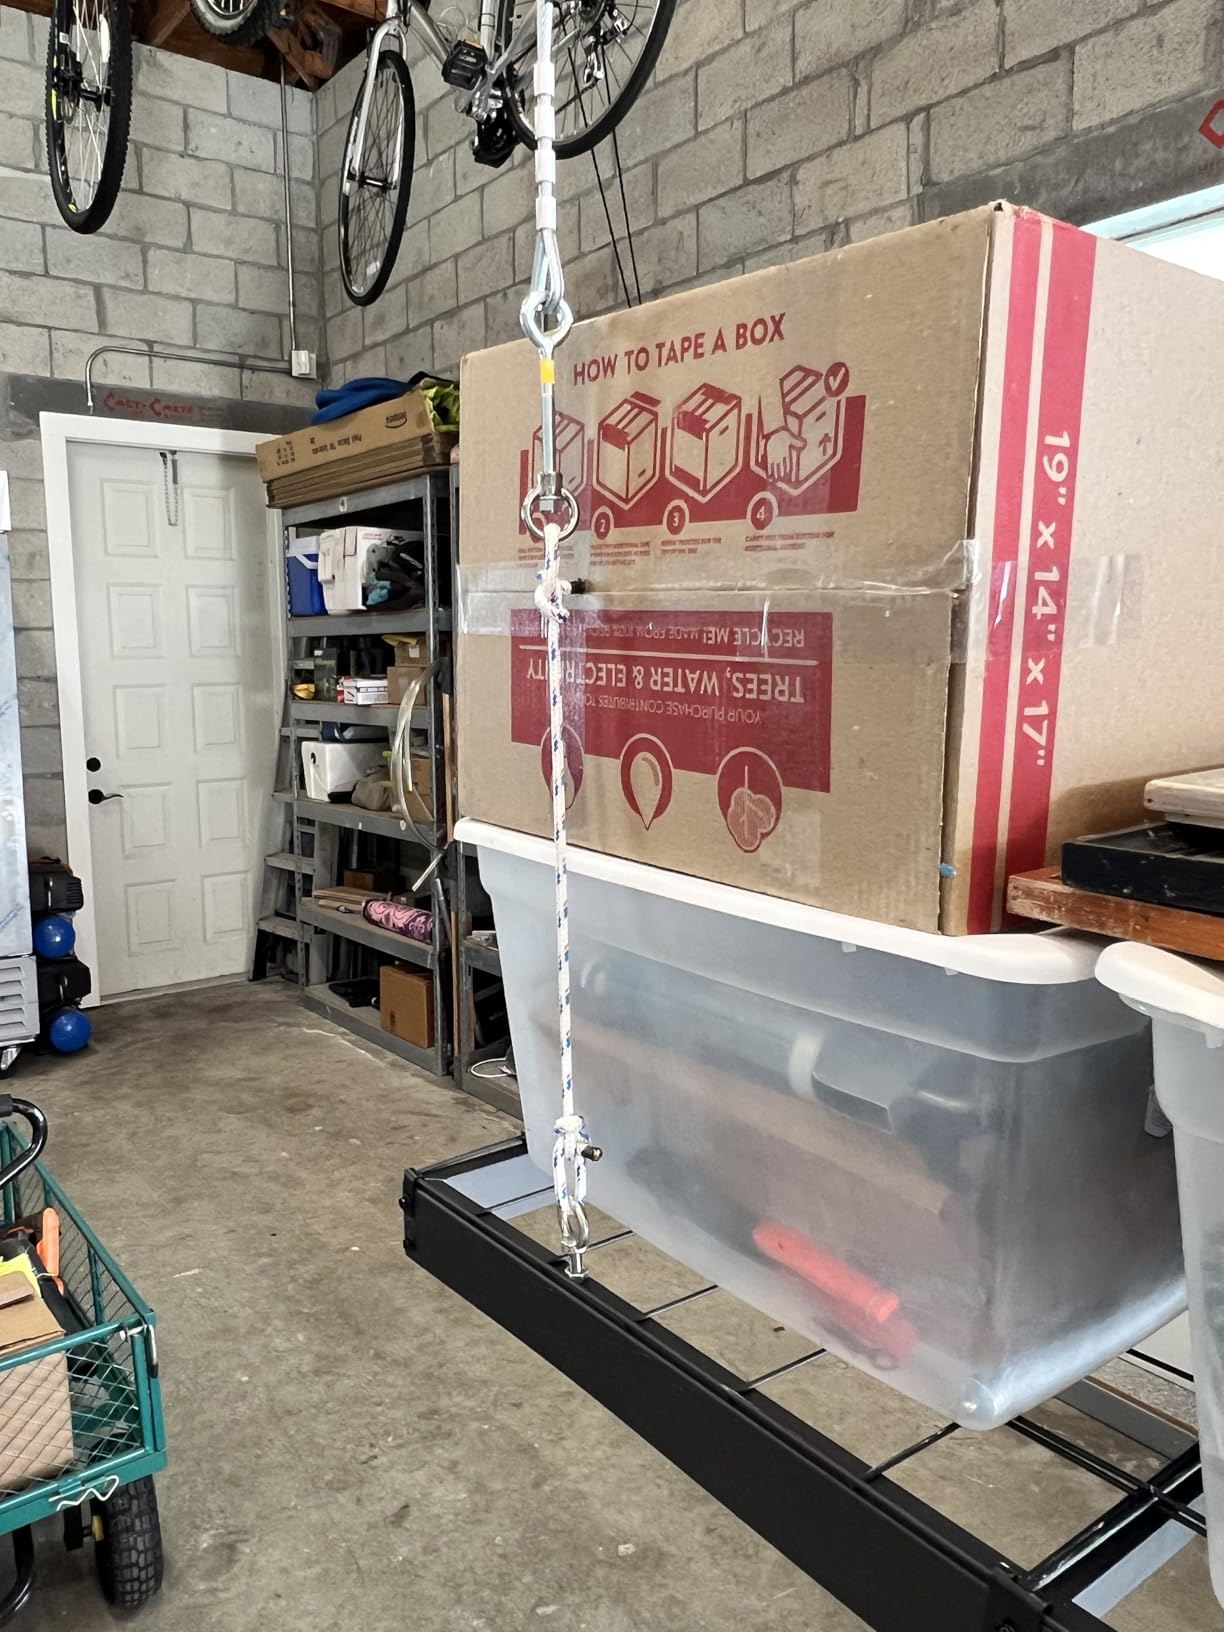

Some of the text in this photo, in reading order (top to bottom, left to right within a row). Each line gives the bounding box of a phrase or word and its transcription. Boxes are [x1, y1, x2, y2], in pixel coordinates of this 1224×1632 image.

[573, 312, 787, 386] HOW TO TAPE A BOX
[1043, 430, 1071, 505] 19"
[1032, 566, 1060, 642] 14"
[703, 626, 730, 645] ME!
[733, 628, 805, 648] RECYCLE
[526, 658, 805, 703] TREES, WATER & ELECTRIITY
[585, 693, 762, 724] YOUR PURCHASE CONTRIBUTES TO
[1022, 700, 1048, 767] 17"
